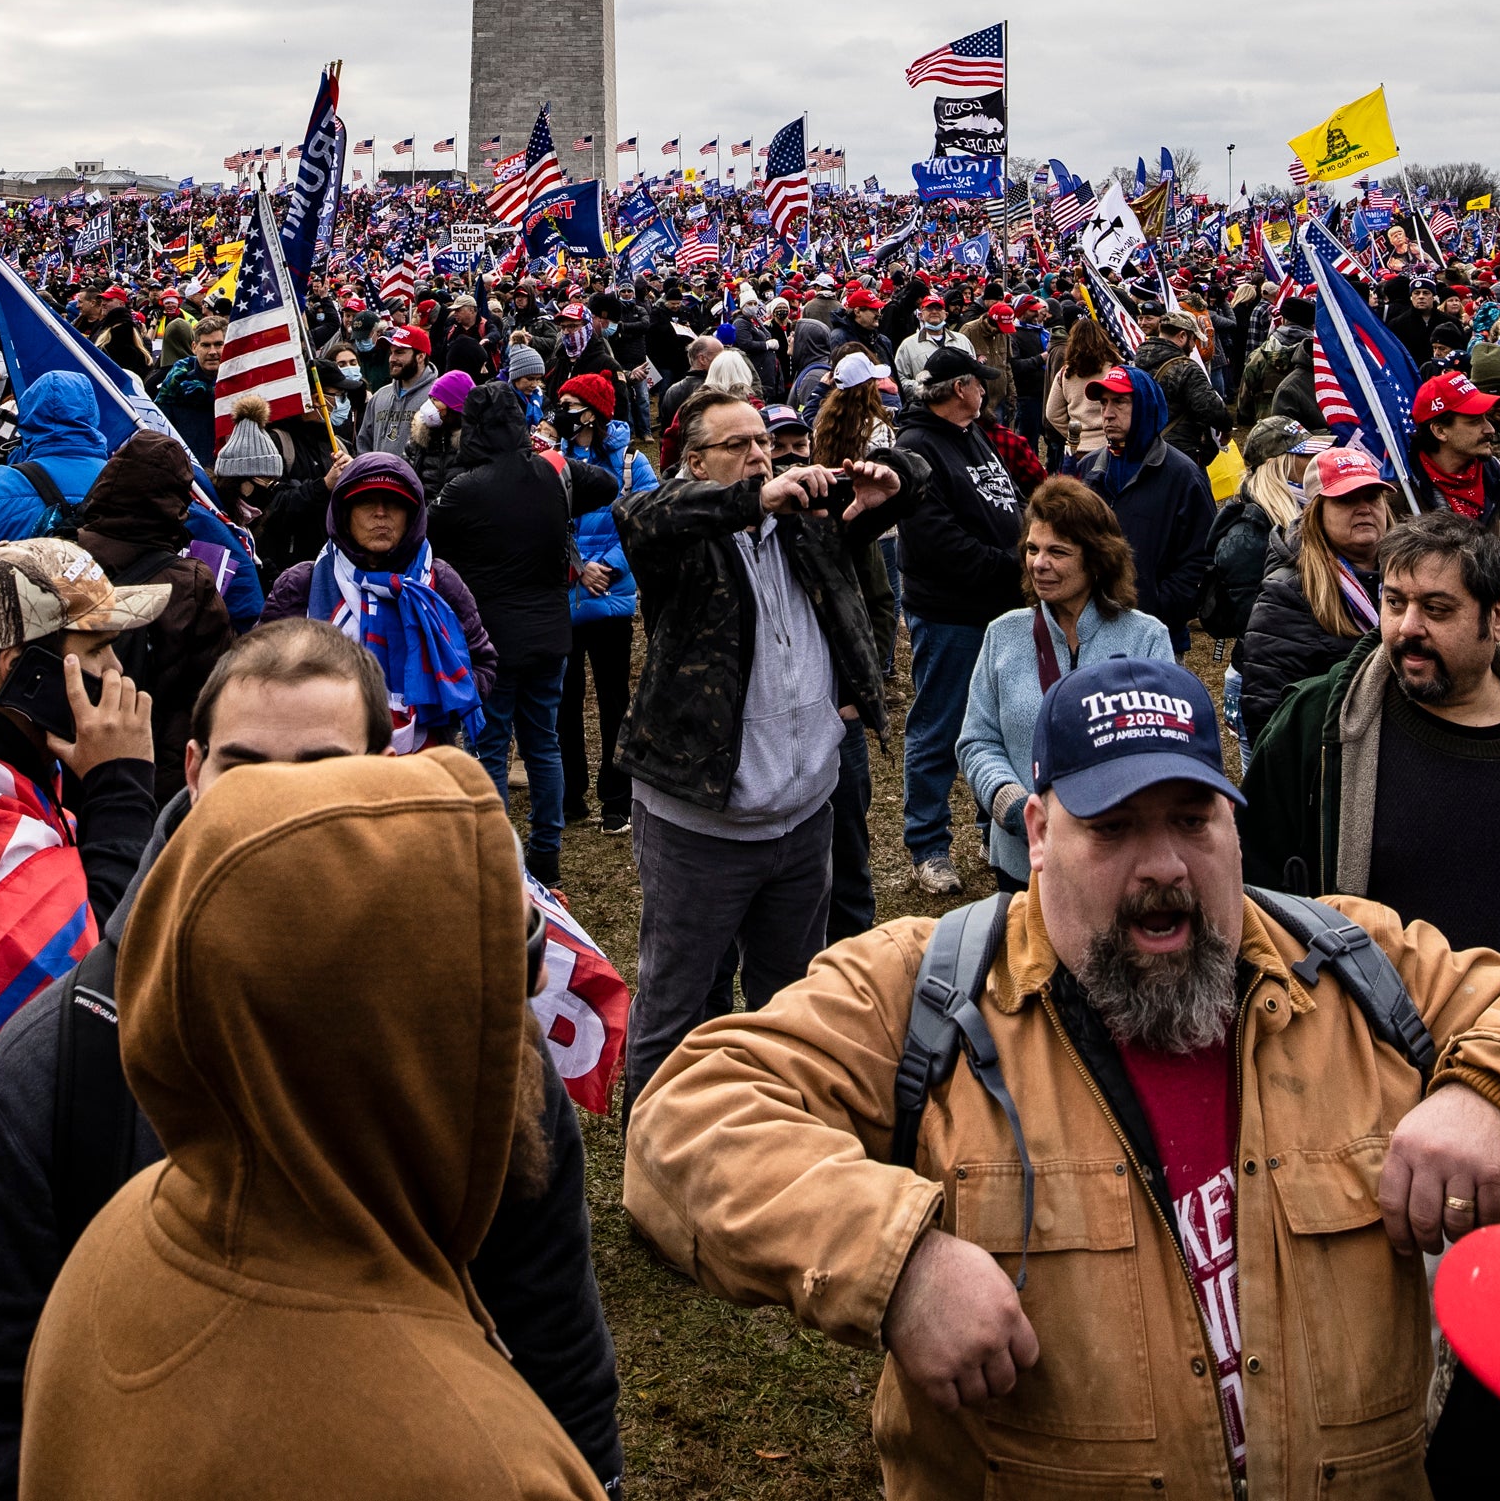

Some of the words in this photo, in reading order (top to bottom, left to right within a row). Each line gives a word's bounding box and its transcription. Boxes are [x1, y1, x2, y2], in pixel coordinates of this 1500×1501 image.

[495, 155, 527, 176] TRUM
[453, 226, 479, 235] Biden
[457, 243, 478, 251] OUT
[1430, 397, 1445, 411] 45
[1081, 690, 1193, 725] Trump
[1125, 712, 1165, 727] 2020
[1093, 733, 1115, 748] KEEP
[1116, 728, 1158, 741] AMERICA
[1160, 728, 1190, 743] GREAT!
[74, 996, 95, 1009] SWISS
[100, 1007, 118, 1023] GEAR
